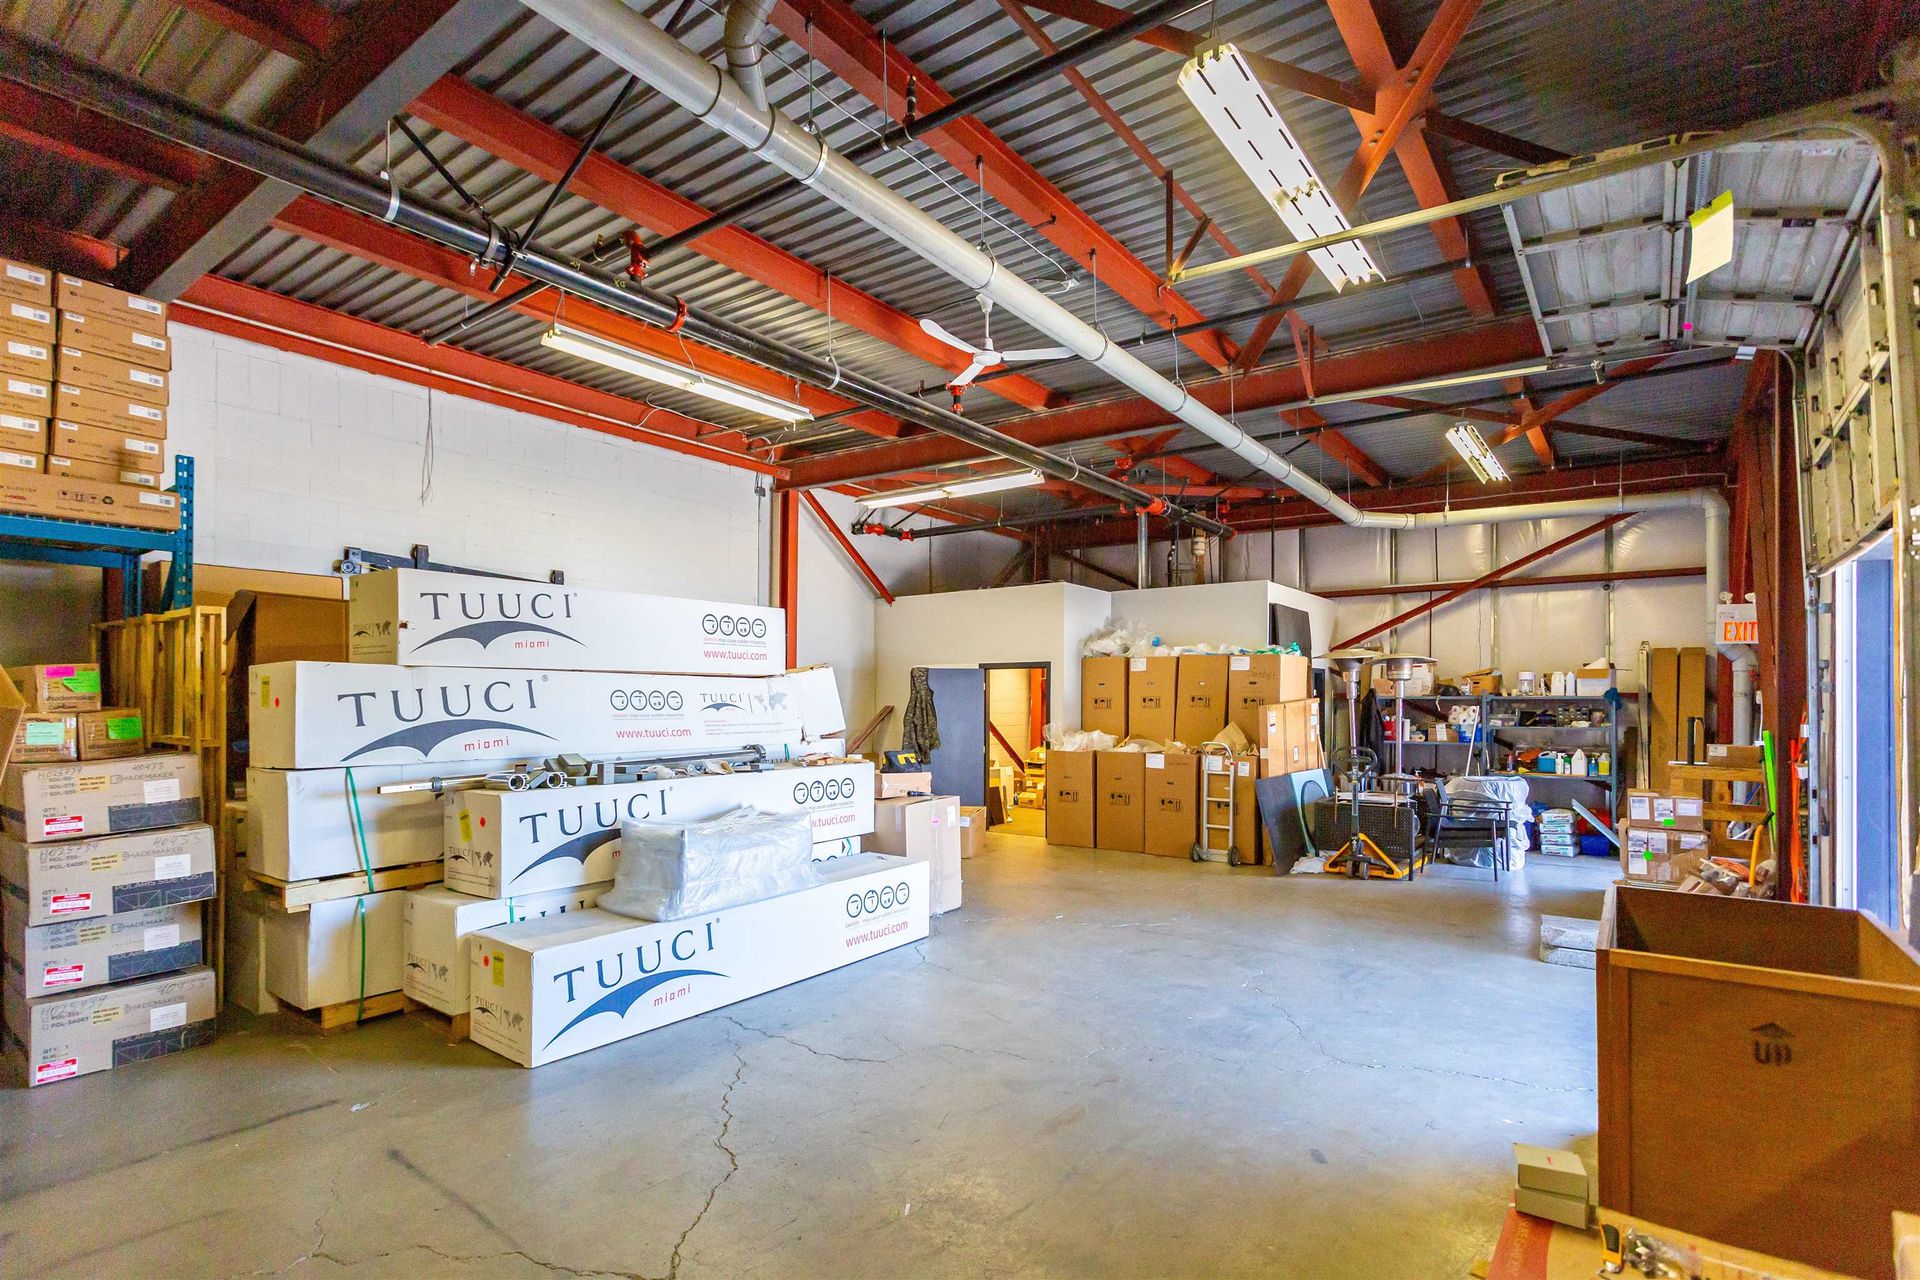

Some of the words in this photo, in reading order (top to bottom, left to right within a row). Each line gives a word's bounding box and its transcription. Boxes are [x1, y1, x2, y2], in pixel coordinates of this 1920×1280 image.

[420, 592, 572, 620] TUUCI
[1724, 621, 1759, 641] EXIT
[514, 638, 550, 649] miami
[703, 650, 768, 661] www.tuuci.com
[337, 679, 537, 727] TUUCI
[699, 692, 742, 703] TUUCI
[464, 735, 510, 752] miami
[615, 727, 692, 739] www.tuuci.com
[519, 789, 668, 844] TUUCI
[845, 920, 909, 948] www.tuuci.com
[553, 922, 715, 1003] TUUCI
[653, 983, 691, 1008] miami
